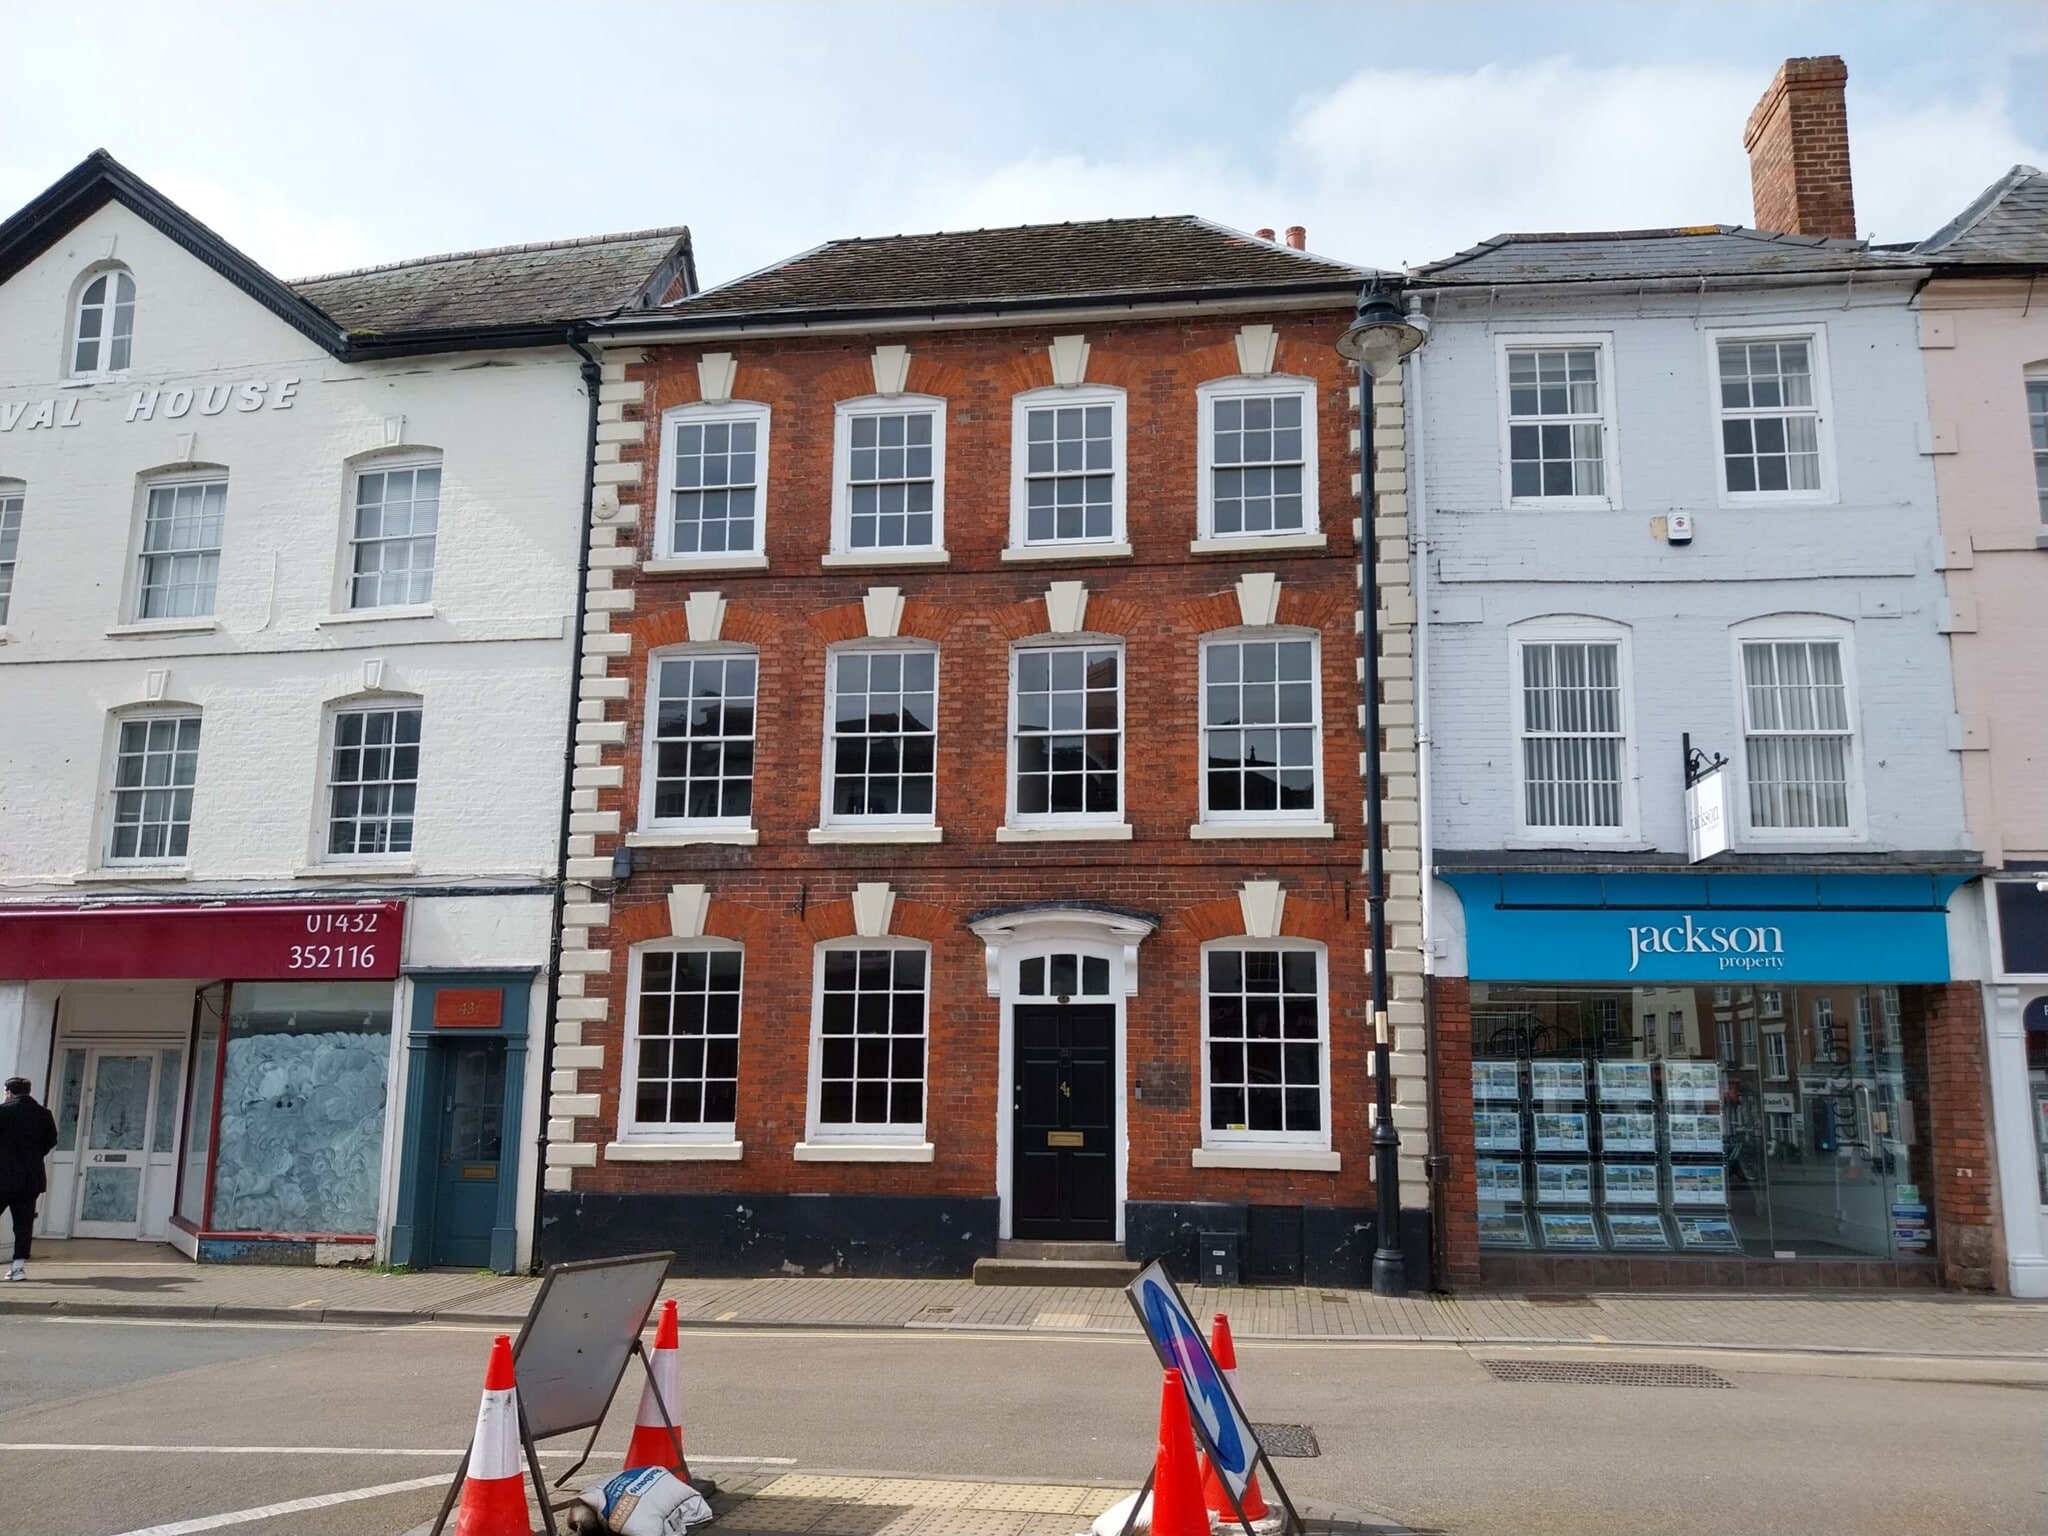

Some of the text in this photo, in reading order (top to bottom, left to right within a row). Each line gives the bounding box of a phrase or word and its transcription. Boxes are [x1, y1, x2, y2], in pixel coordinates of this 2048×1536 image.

[125, 376, 301, 422] HOUSE
[306, 913, 378, 933] 01432
[1628, 915, 1785, 972] jackson
[288, 945, 377, 969] 352116
[1719, 956, 1785, 970] property
[93, 1153, 103, 1163] 42
